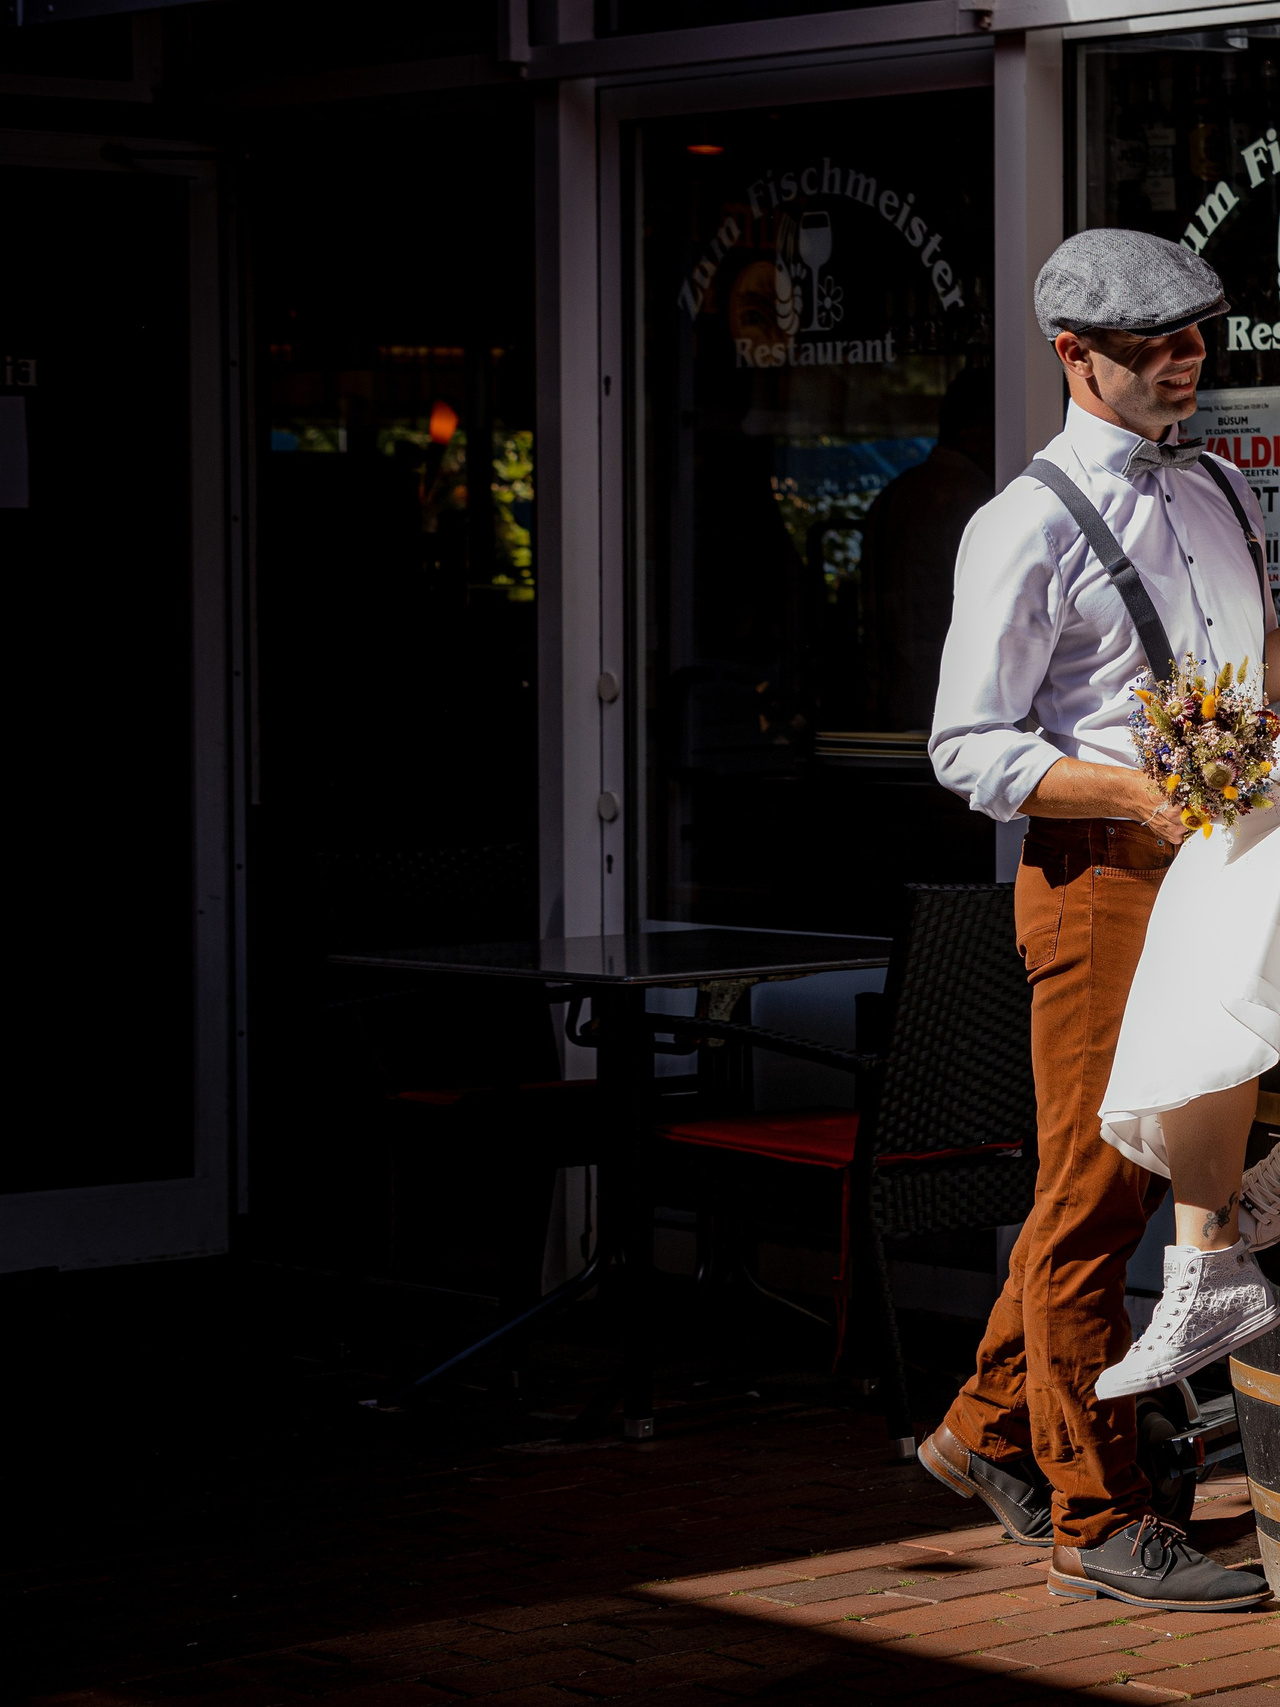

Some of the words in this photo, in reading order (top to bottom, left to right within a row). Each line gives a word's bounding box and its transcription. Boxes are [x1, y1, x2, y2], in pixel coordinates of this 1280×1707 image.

[1179, 181, 1241, 256] um
[677, 216, 743, 322] Zum
[745, 156, 966, 312] Fischmeister
[734, 330, 897, 368] Restaurant
[1214, 427, 1239, 435] CLEMENS
[1217, 415, 1249, 426] BÜSUM
